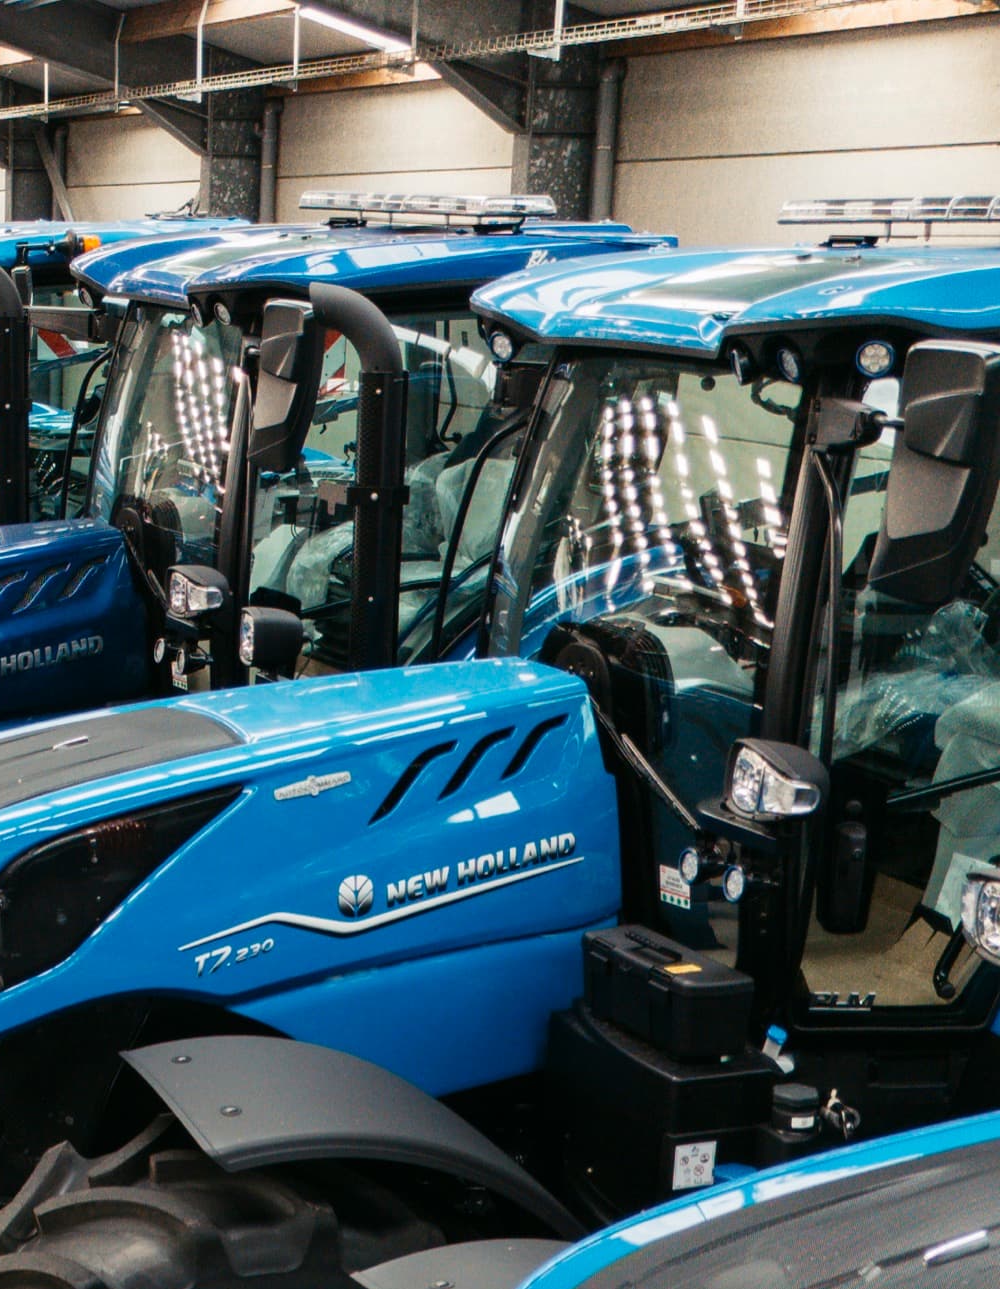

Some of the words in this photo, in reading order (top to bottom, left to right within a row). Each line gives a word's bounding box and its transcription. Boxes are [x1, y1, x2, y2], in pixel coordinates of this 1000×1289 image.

[0, 635, 104, 677] HOLLAND
[386, 866, 450, 908] NEW
[456, 832, 576, 886] HOLLAND
[194, 938, 275, 977] T7.230
[808, 991, 877, 1008] PLM
